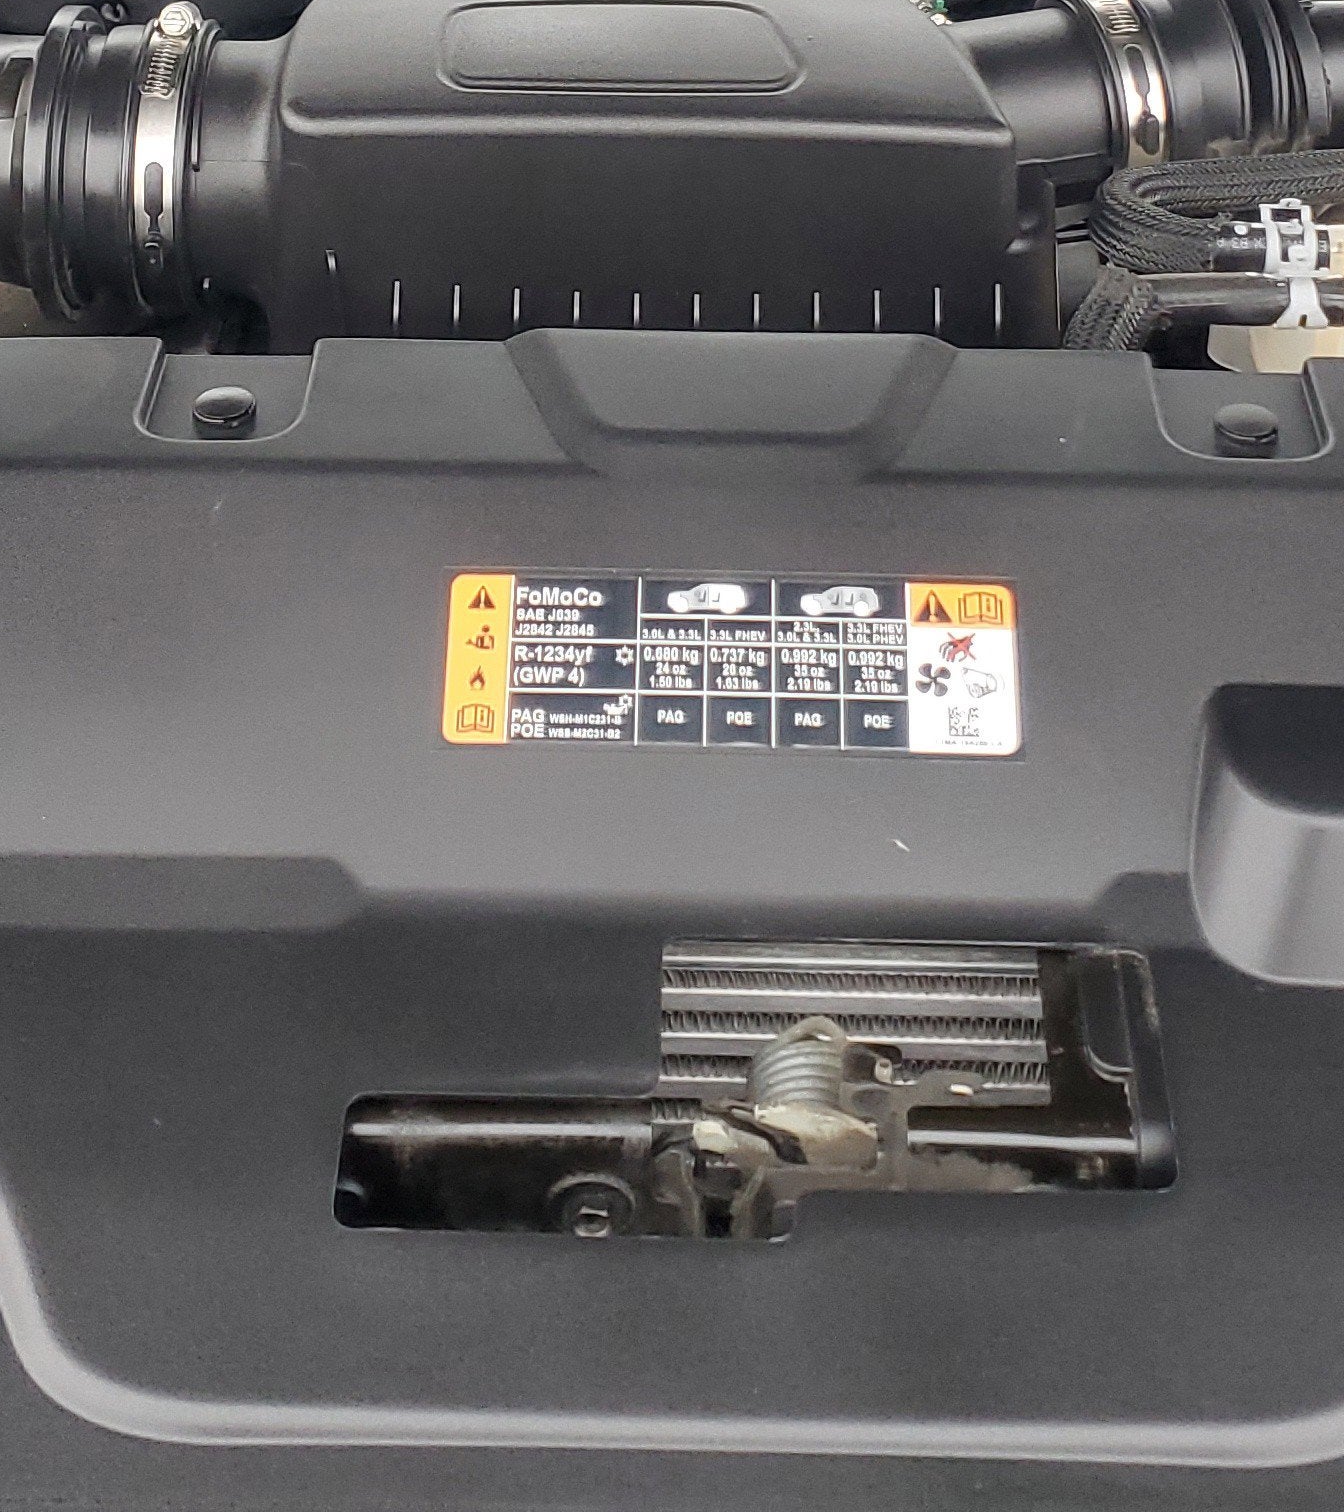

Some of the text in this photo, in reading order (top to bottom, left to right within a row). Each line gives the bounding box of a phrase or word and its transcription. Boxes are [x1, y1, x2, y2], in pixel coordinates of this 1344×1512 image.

[516, 586, 603, 606] FoMoCo
[667, 629, 676, 639] &
[802, 632, 811, 642] &
[847, 633, 903, 644] 3.0L PHEV
[514, 645, 593, 666] R-1234yf
[682, 647, 699, 666] kg
[710, 648, 765, 667] 0.737 kg
[781, 648, 837, 667] 0.992 kg
[887, 651, 904, 670] kg
[656, 661, 687, 675] 24 oz
[738, 665, 753, 676] oz
[794, 664, 825, 677] 35 oz
[861, 666, 892, 679] 35 oz
[513, 667, 585, 687] (GWP 4)
[675, 676, 693, 689] lbs
[741, 677, 759, 690] lbs
[813, 678, 831, 691] lbs
[880, 681, 898, 693] lbs
[511, 709, 545, 723] PAG
[657, 709, 684, 724] PAG
[726, 711, 753, 725] POE
[794, 713, 822, 727] PAG
[863, 714, 891, 729] POE
[511, 724, 545, 738] POE
